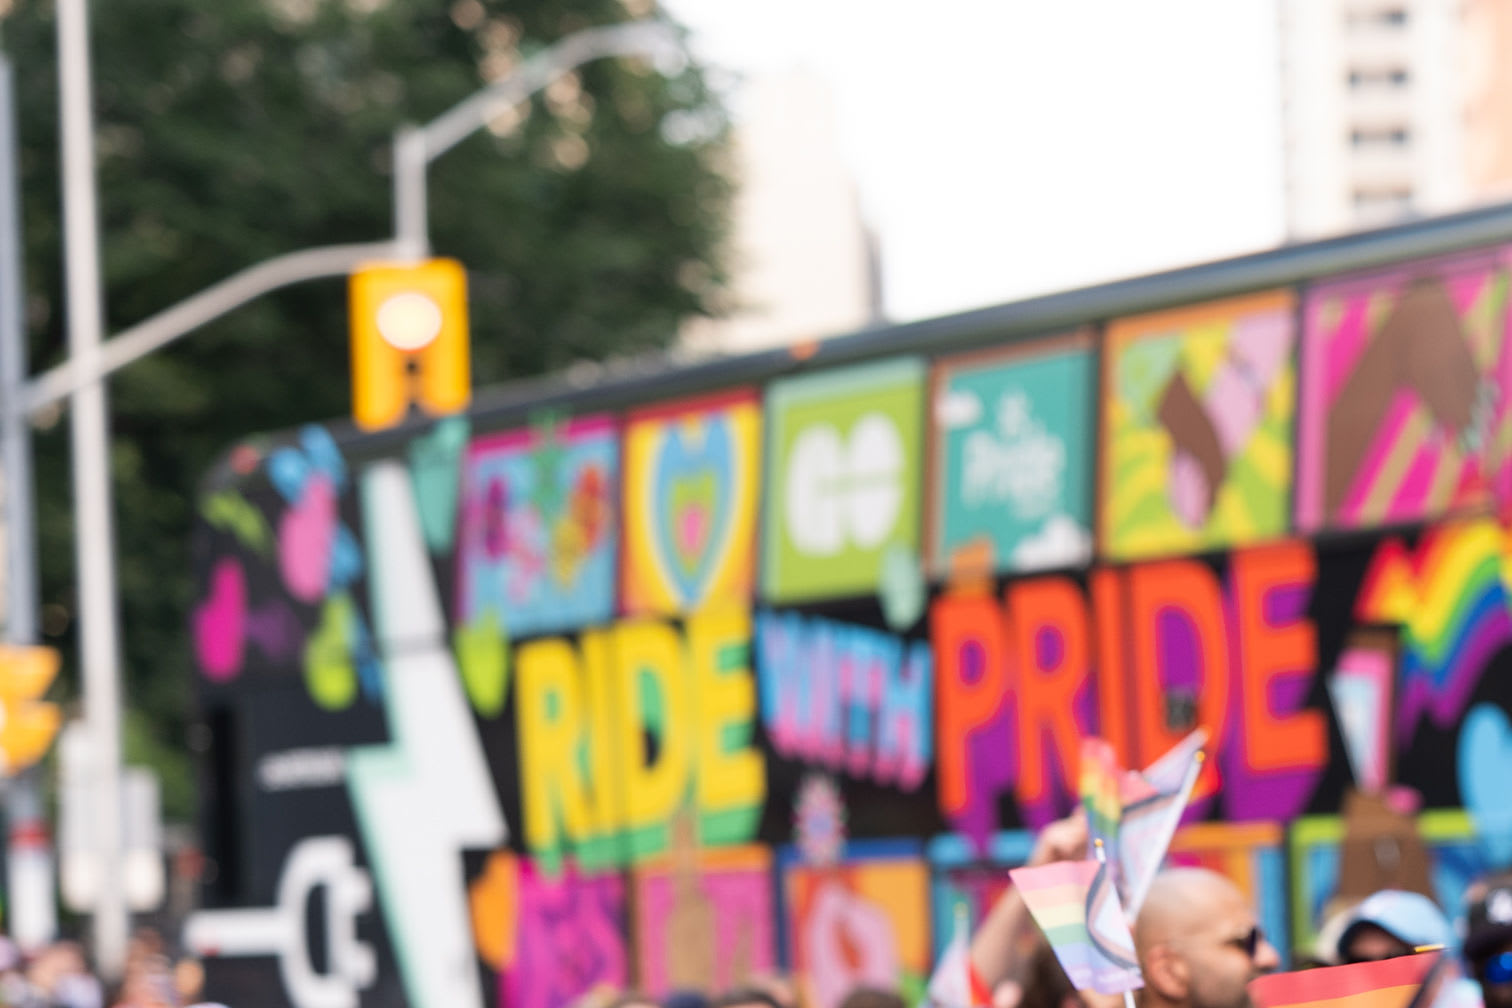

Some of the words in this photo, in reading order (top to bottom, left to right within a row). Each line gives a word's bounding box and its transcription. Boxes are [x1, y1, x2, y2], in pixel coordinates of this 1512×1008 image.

[515, 606, 766, 866] RIDE
[754, 610, 932, 788] WITH
[930, 540, 1330, 830] PRIDE
